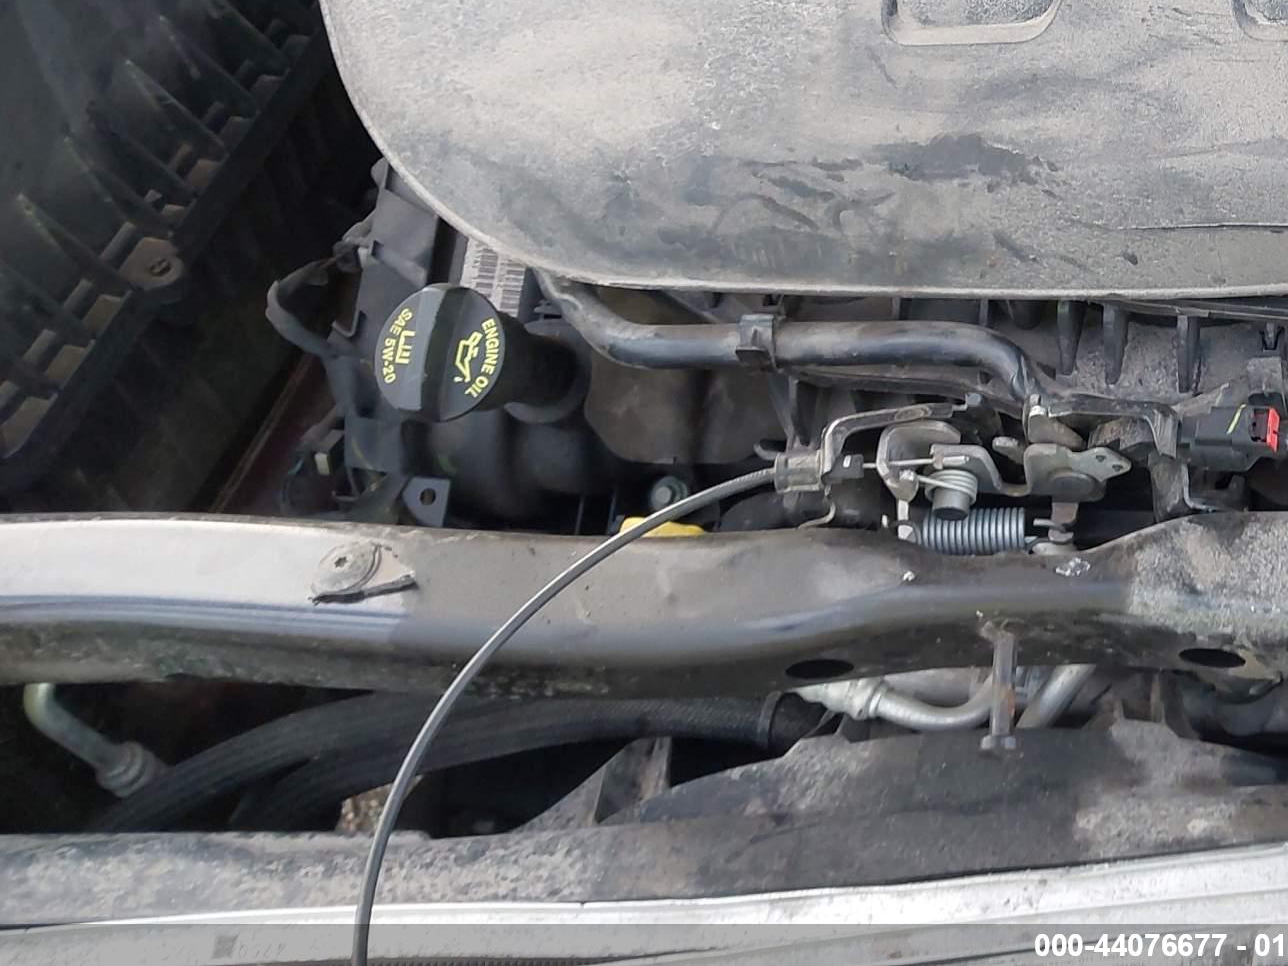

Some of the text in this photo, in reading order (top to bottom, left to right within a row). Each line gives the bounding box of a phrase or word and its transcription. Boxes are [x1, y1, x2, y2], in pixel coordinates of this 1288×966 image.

[382, 308, 413, 384] SAE 5W-20
[464, 318, 499, 398] ENGINE OIL
